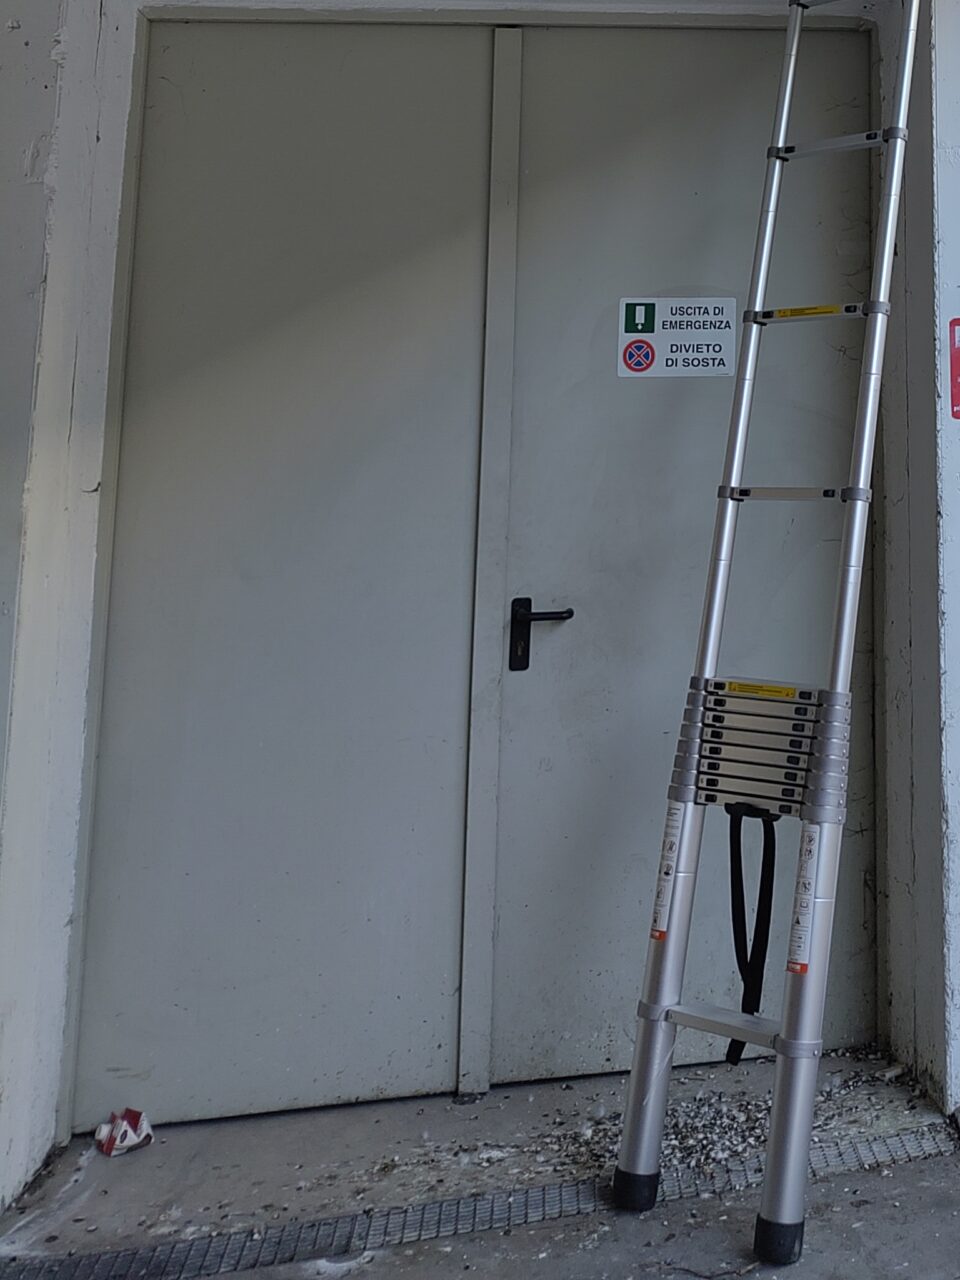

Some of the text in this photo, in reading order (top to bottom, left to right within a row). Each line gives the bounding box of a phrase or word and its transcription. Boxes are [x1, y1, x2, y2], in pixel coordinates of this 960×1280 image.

[670, 306, 724, 316] USCITA DI
[661, 320, 732, 330] EMERGENZA
[670, 343, 722, 354] DIVIETO
[665, 357, 726, 368] DI SOSTA
